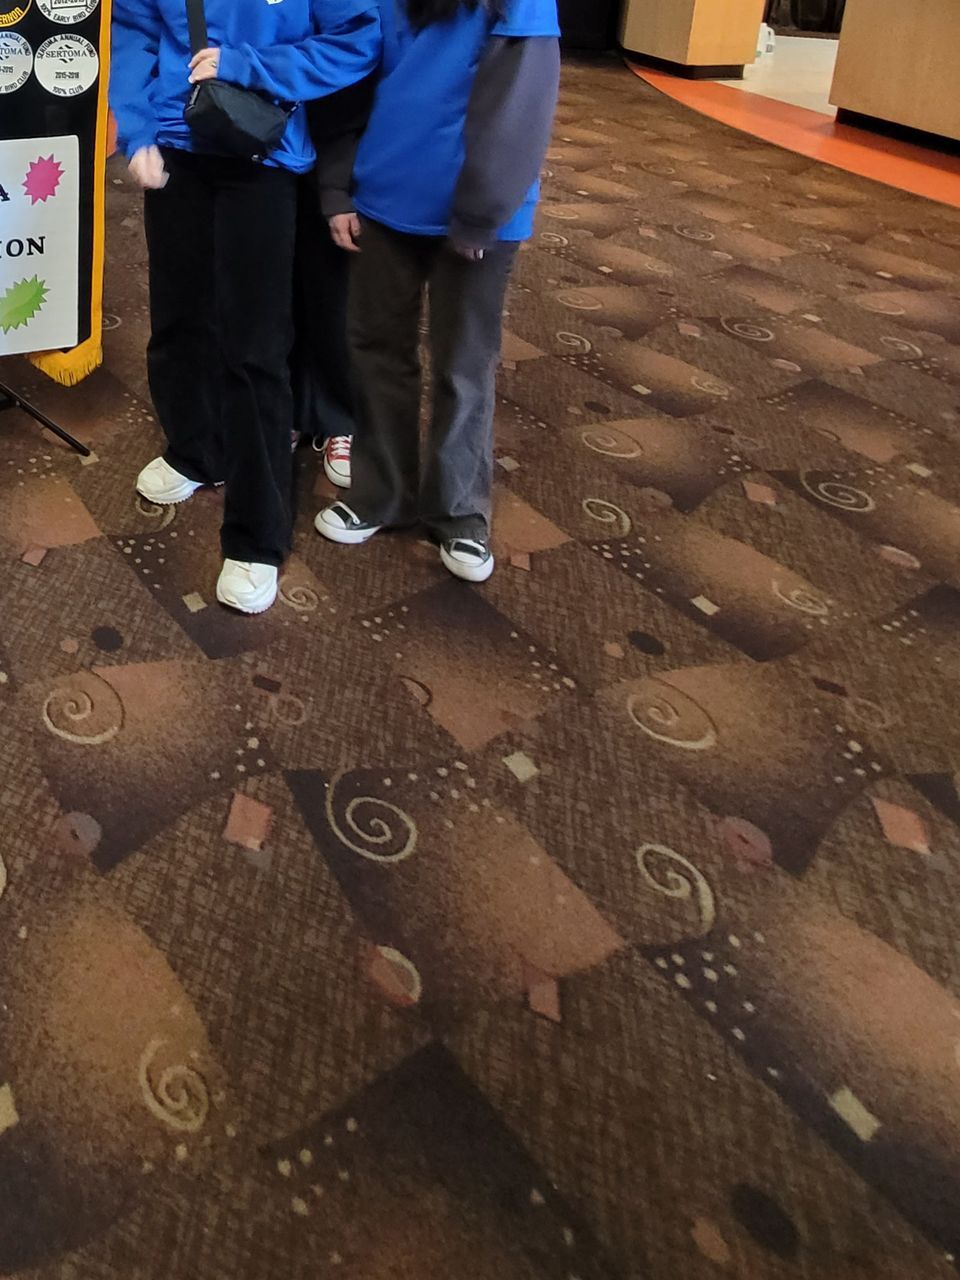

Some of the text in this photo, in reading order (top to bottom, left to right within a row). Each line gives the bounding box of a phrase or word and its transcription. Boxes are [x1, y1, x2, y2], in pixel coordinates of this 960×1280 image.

[45, 50, 87, 59] SERTOMA
[16, 70, 29, 85] CLUB
[68, 84, 84, 95] CLUB
